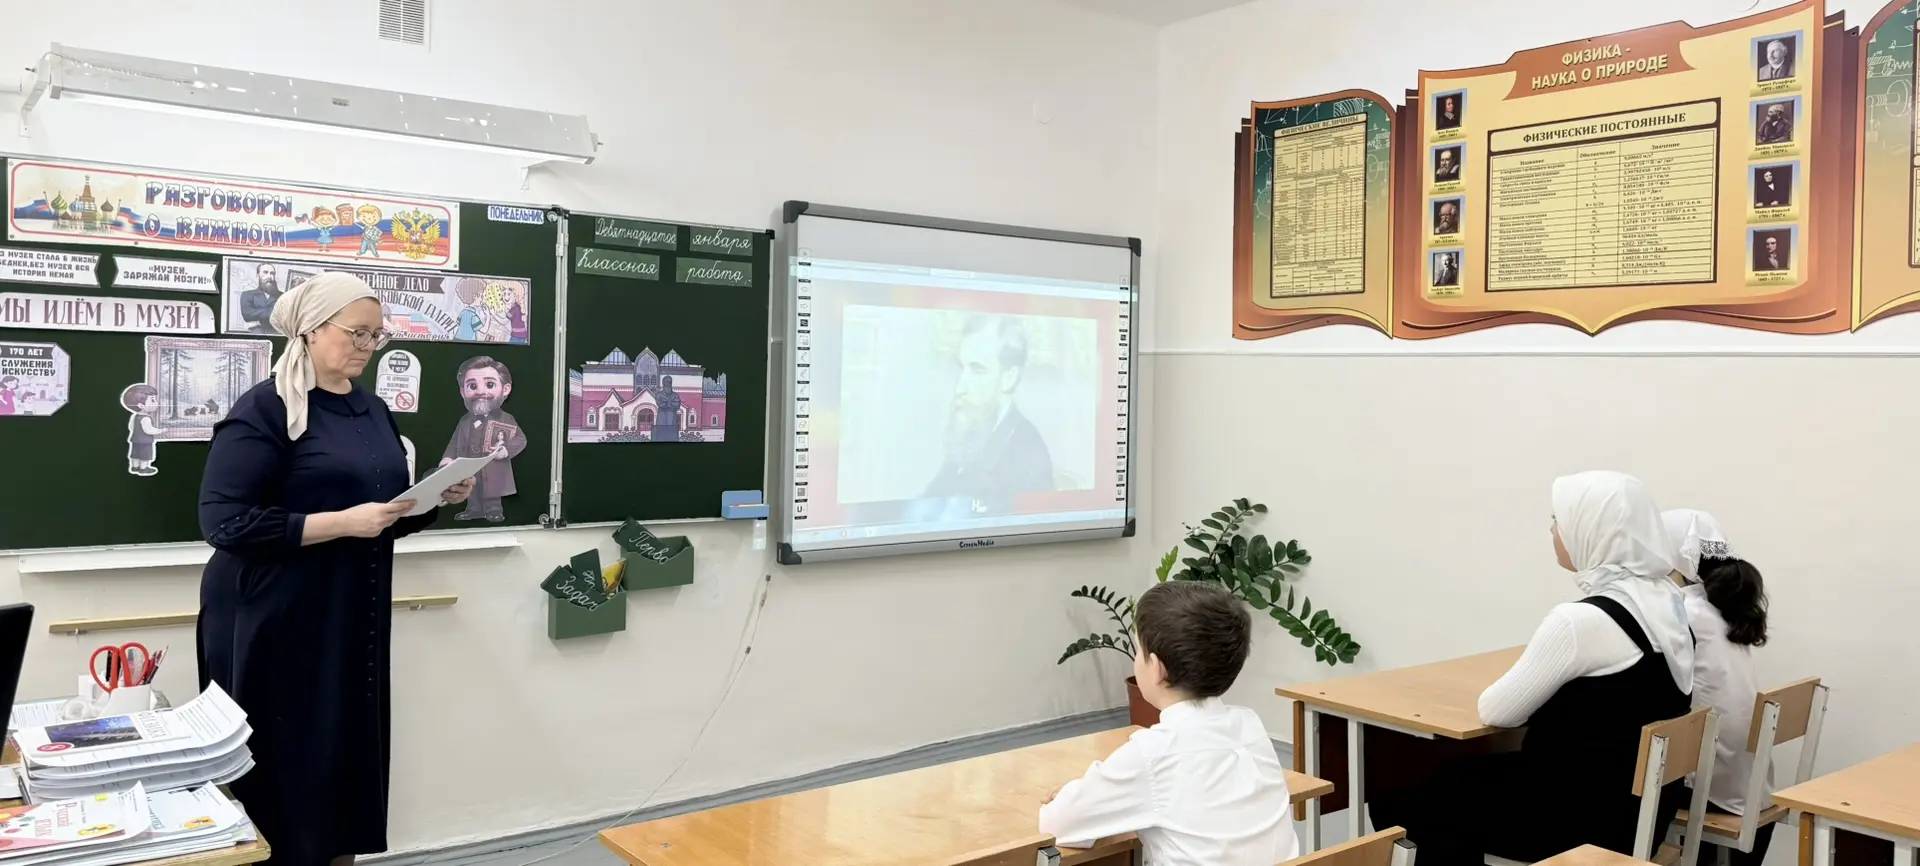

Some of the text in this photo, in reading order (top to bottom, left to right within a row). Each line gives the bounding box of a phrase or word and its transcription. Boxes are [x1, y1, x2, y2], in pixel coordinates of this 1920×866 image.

[1561, 43, 1622, 66] ФИЗИКА
[1531, 54, 1668, 91] НАУКА О ПРИРОДЕ
[1522, 112, 1686, 143] ФИЗИЧЕСКИЕ ПОСТОЯННЫЕ
[145, 181, 293, 217] РАЗГОВОРЫ
[490, 206, 543, 223] ПОНЕДЕЛЬНИК
[143, 212, 287, 248] О ВАЖНОМ
[595, 218, 751, 254] Девятнадцатое января
[8, 251, 33, 259] МУЗЕЯ
[36, 253, 60, 261] СТАЛА
[71, 256, 97, 264] ЖИЗНЬ
[47, 262, 72, 270] МУЗЕЯ
[577, 248, 743, 283] Классная работа
[13, 269, 75, 279] ИСТОРИЯ НЕМАЯ
[357, 272, 430, 291] ЗЕЙНОЕ ДЕЛО
[43, 298, 103, 327] ИДЁМ
[114, 302, 126, 327] В
[136, 302, 200, 329] МУЗЕЙ
[9, 348, 44, 356] 170 ЛЕТ
[1, 360, 54, 369] СЛУЖЕНИЯ
[2, 367, 56, 376] ИСКУССТВУ
